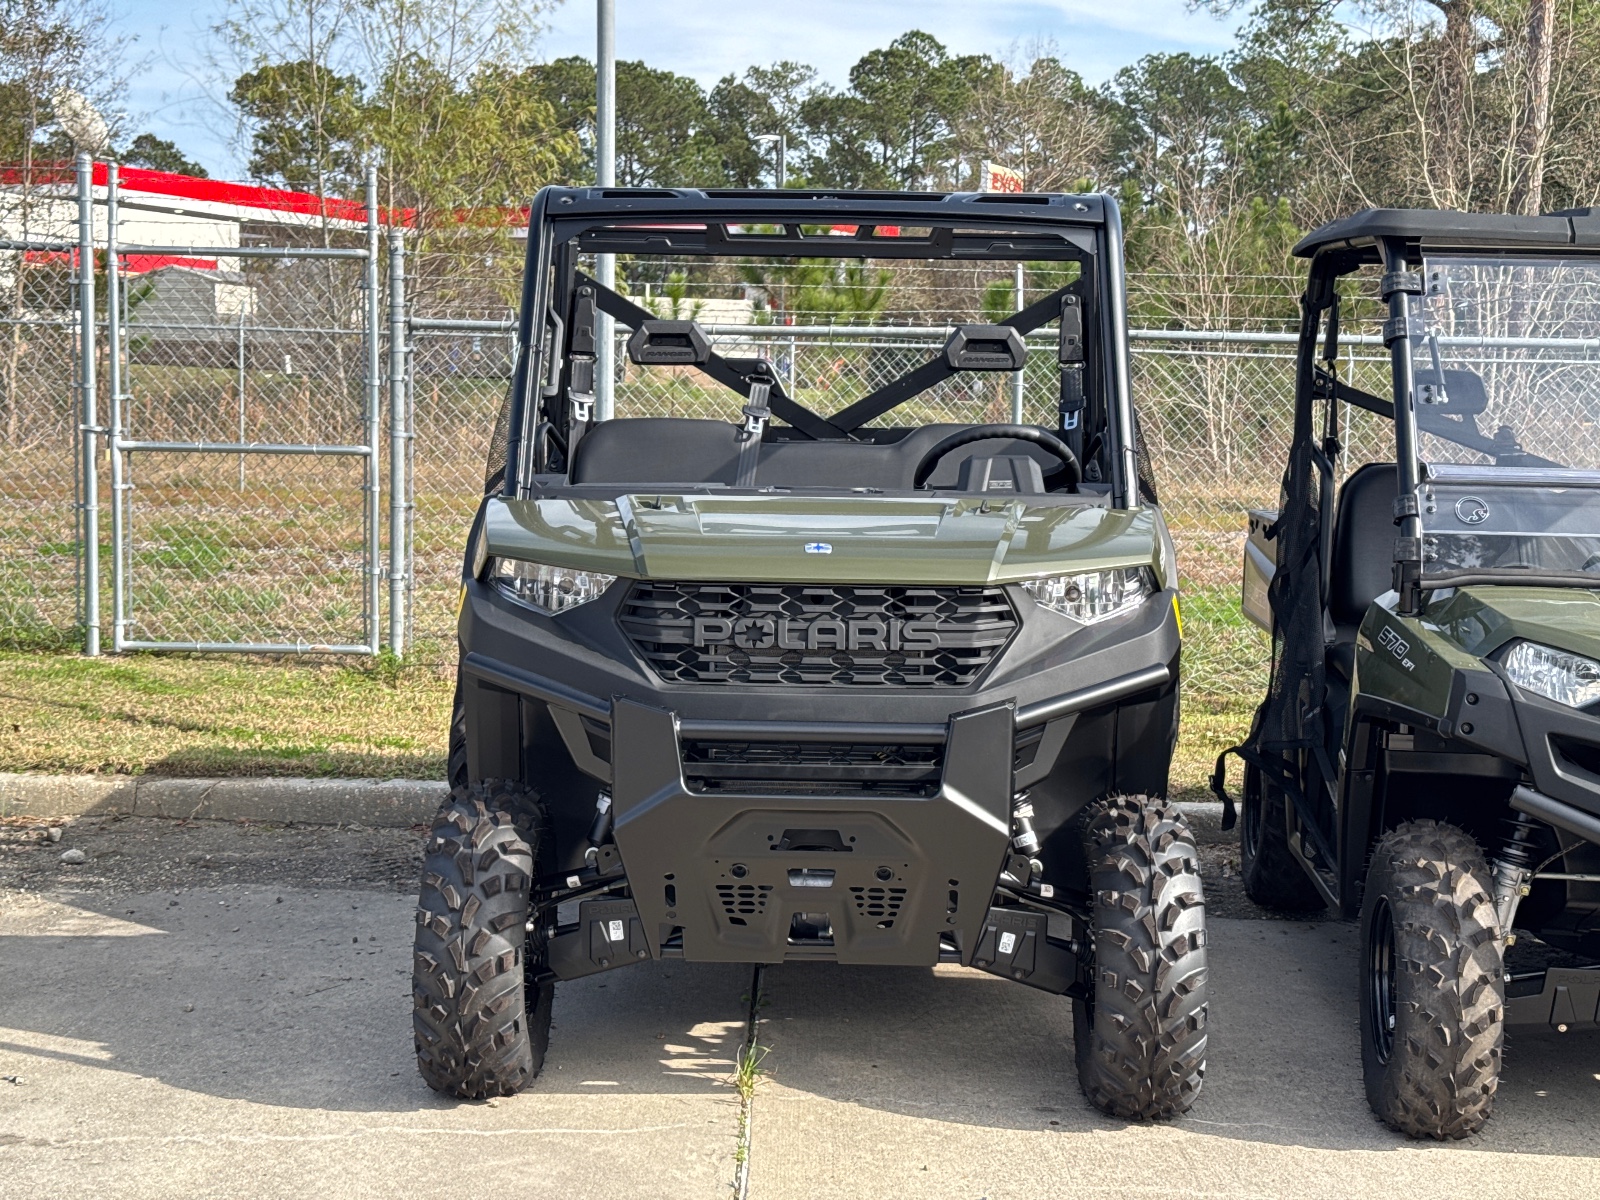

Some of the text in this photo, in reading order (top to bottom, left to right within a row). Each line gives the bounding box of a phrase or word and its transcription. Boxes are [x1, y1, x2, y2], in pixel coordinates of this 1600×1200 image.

[694, 617, 941, 650] POLARIS
[1377, 625, 1416, 672] 570 EFI
